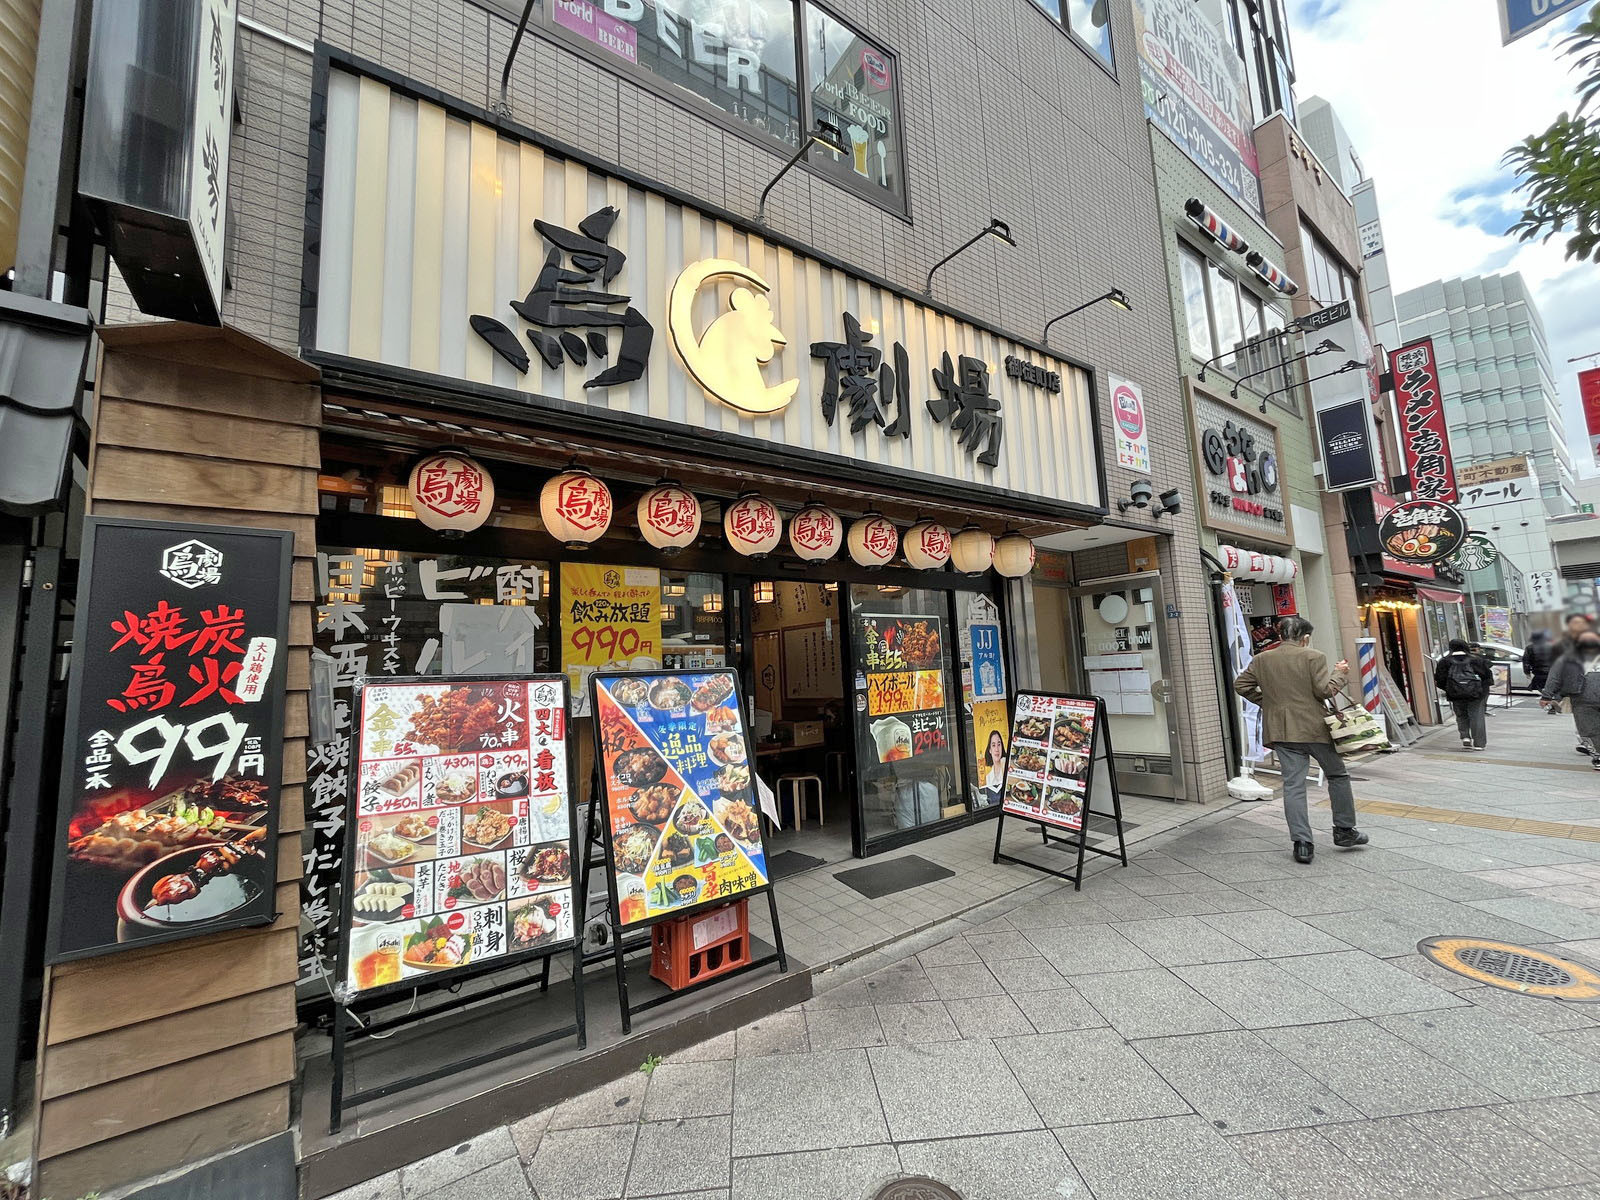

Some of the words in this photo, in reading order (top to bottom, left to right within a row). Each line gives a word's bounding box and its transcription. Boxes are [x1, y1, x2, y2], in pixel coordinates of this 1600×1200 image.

[598, 27, 635, 59] BEER
[848, 101, 886, 134] FOOD
[1155, 93, 1241, 191] 0120-905-334
[415, 459, 483, 514] 鳥劇場
[647, 489, 696, 534] 鳥劇場
[731, 501, 776, 539] 鳥劇場
[793, 505, 835, 547] 鳥劇場
[1391, 505, 1451, 528] 壱角家
[570, 599, 651, 625] 飲み放題
[106, 600, 198, 713] 焼鳥
[179, 604, 247, 706] 炭火
[571, 624, 653, 662] 990円
[864, 625, 880, 670] 金の串
[976, 629, 993, 650] JJ
[242, 641, 268, 696] 大山鶏使用
[868, 674, 917, 691] ハイボール
[875, 691, 909, 713] 199円
[1031, 706, 1053, 714] メニュー
[1032, 696, 1054, 707] ランチ
[497, 698, 526, 747] 火の串
[912, 716, 944, 733] 生ビール
[84, 729, 116, 790] 全品一本
[443, 756, 476, 770] 430円
[675, 751, 708, 774] 料理
[307, 732, 350, 838] 焼餃子
[361, 780, 382, 812] 餃子
[383, 797, 418, 811] 450円
[508, 849, 527, 896] 桜ユッケ
[719, 871, 757, 896] 肉味噌
[483, 905, 504, 954] 刺身
